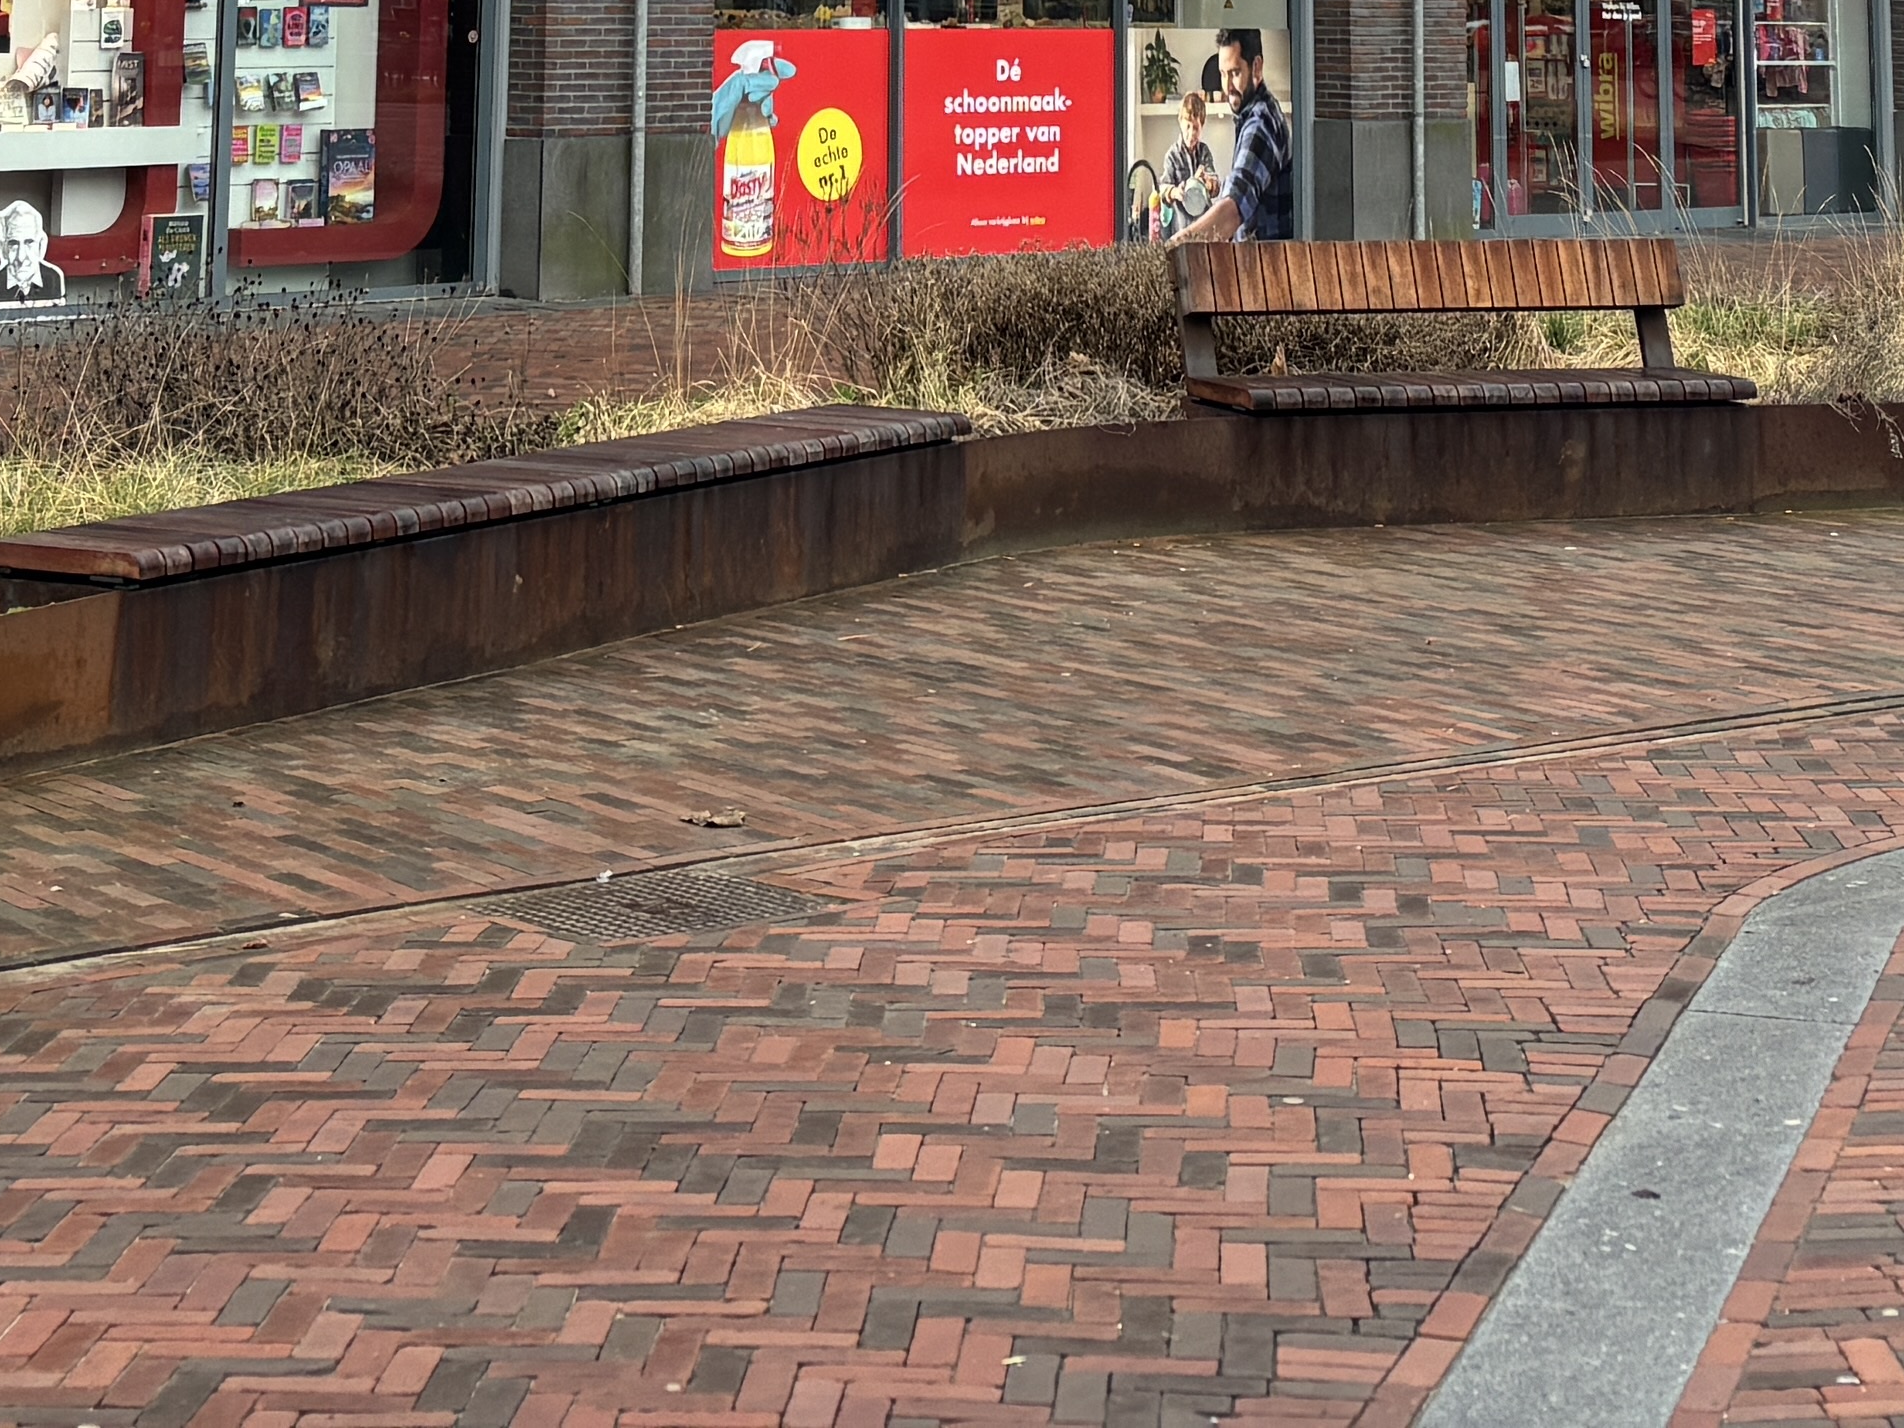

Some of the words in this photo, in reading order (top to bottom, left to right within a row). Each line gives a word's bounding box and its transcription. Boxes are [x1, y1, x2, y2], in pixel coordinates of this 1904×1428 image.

[996, 58, 1021, 81] Dé
[944, 87, 1072, 114] schoonmaak-
[1594, 52, 1615, 140] wibra
[818, 127, 837, 144] De
[954, 124, 1020, 150] topper
[1025, 125, 1061, 142] van
[814, 145, 848, 168] echte
[956, 147, 1059, 176] Nederland
